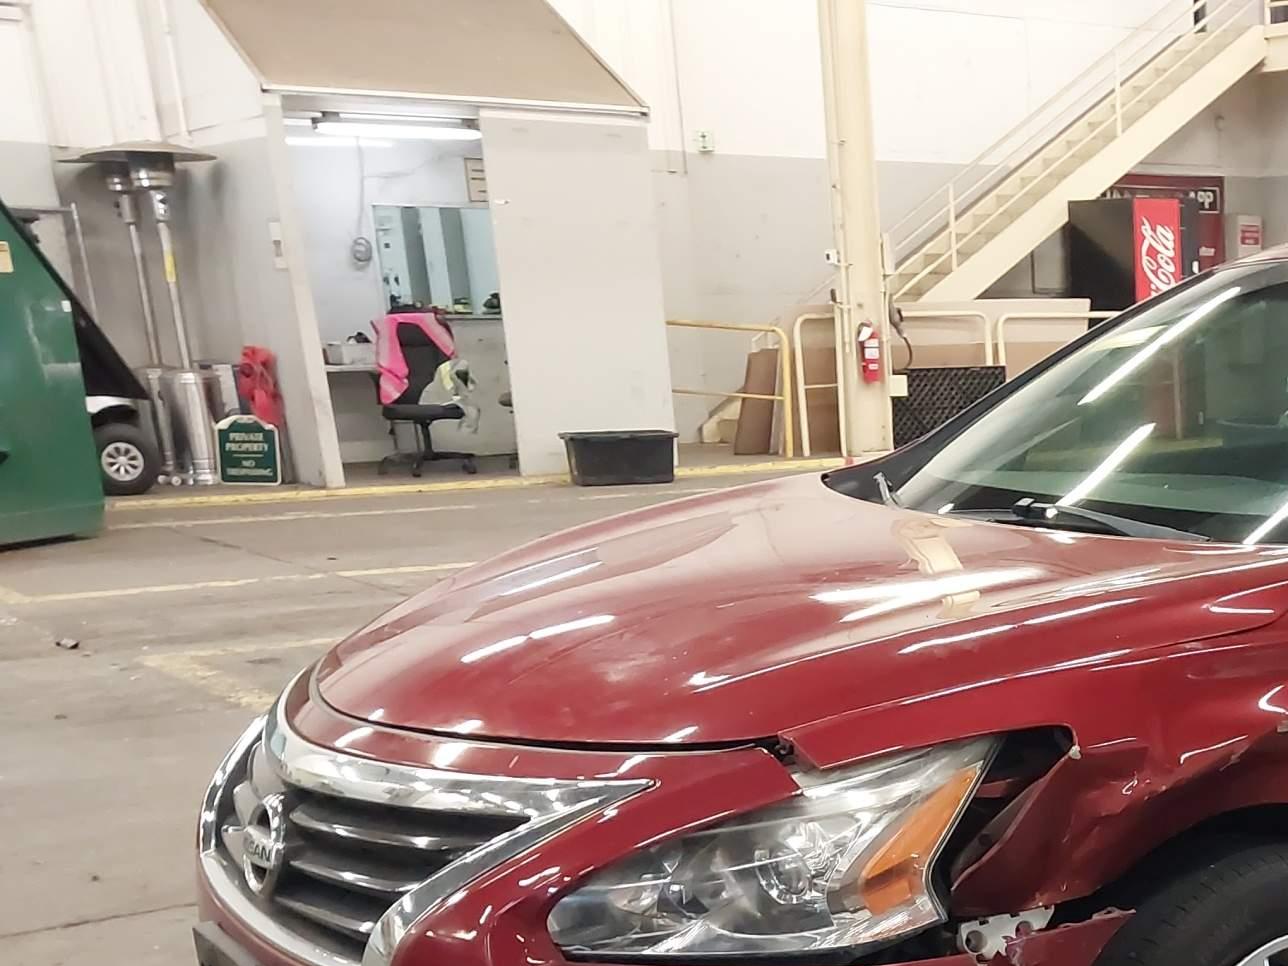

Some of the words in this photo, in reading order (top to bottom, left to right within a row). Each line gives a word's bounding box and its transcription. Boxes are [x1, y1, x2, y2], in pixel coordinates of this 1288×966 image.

[1141, 216, 1177, 297] Cola
[229, 432, 264, 441] PRIVATE
[225, 442, 269, 452] PROPERTY
[241, 459, 256, 467] NO
